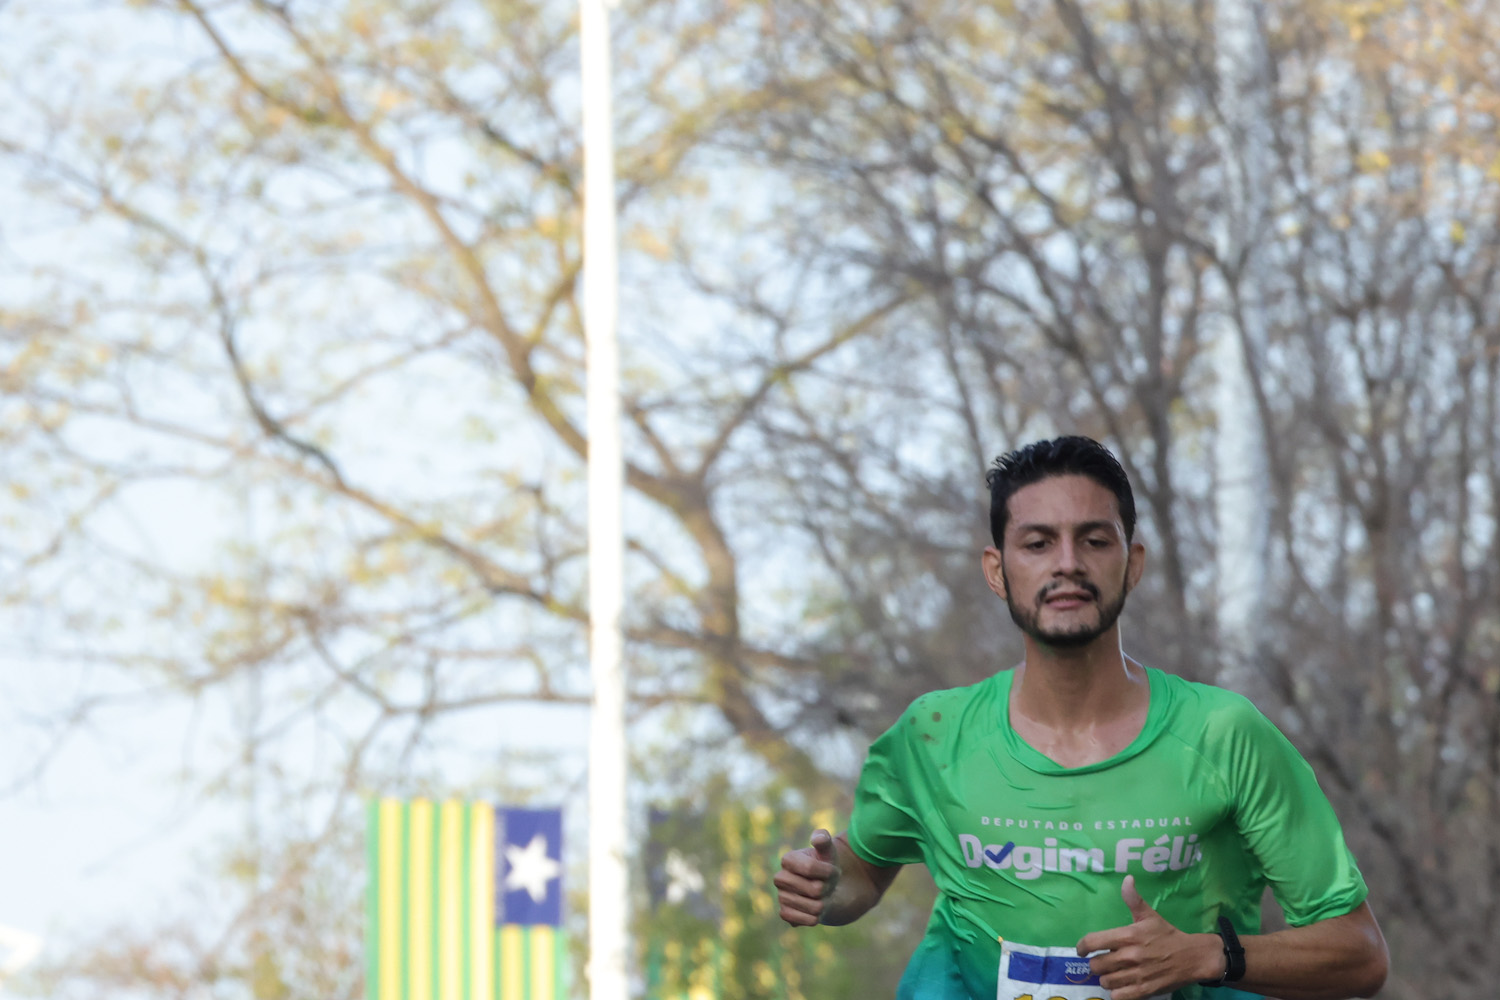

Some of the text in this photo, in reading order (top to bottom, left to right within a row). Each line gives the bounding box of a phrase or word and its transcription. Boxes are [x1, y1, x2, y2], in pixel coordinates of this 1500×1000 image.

[981, 816, 1193, 831] DEPUTADO ESTADUAL
[958, 833, 1105, 880] Dogim
